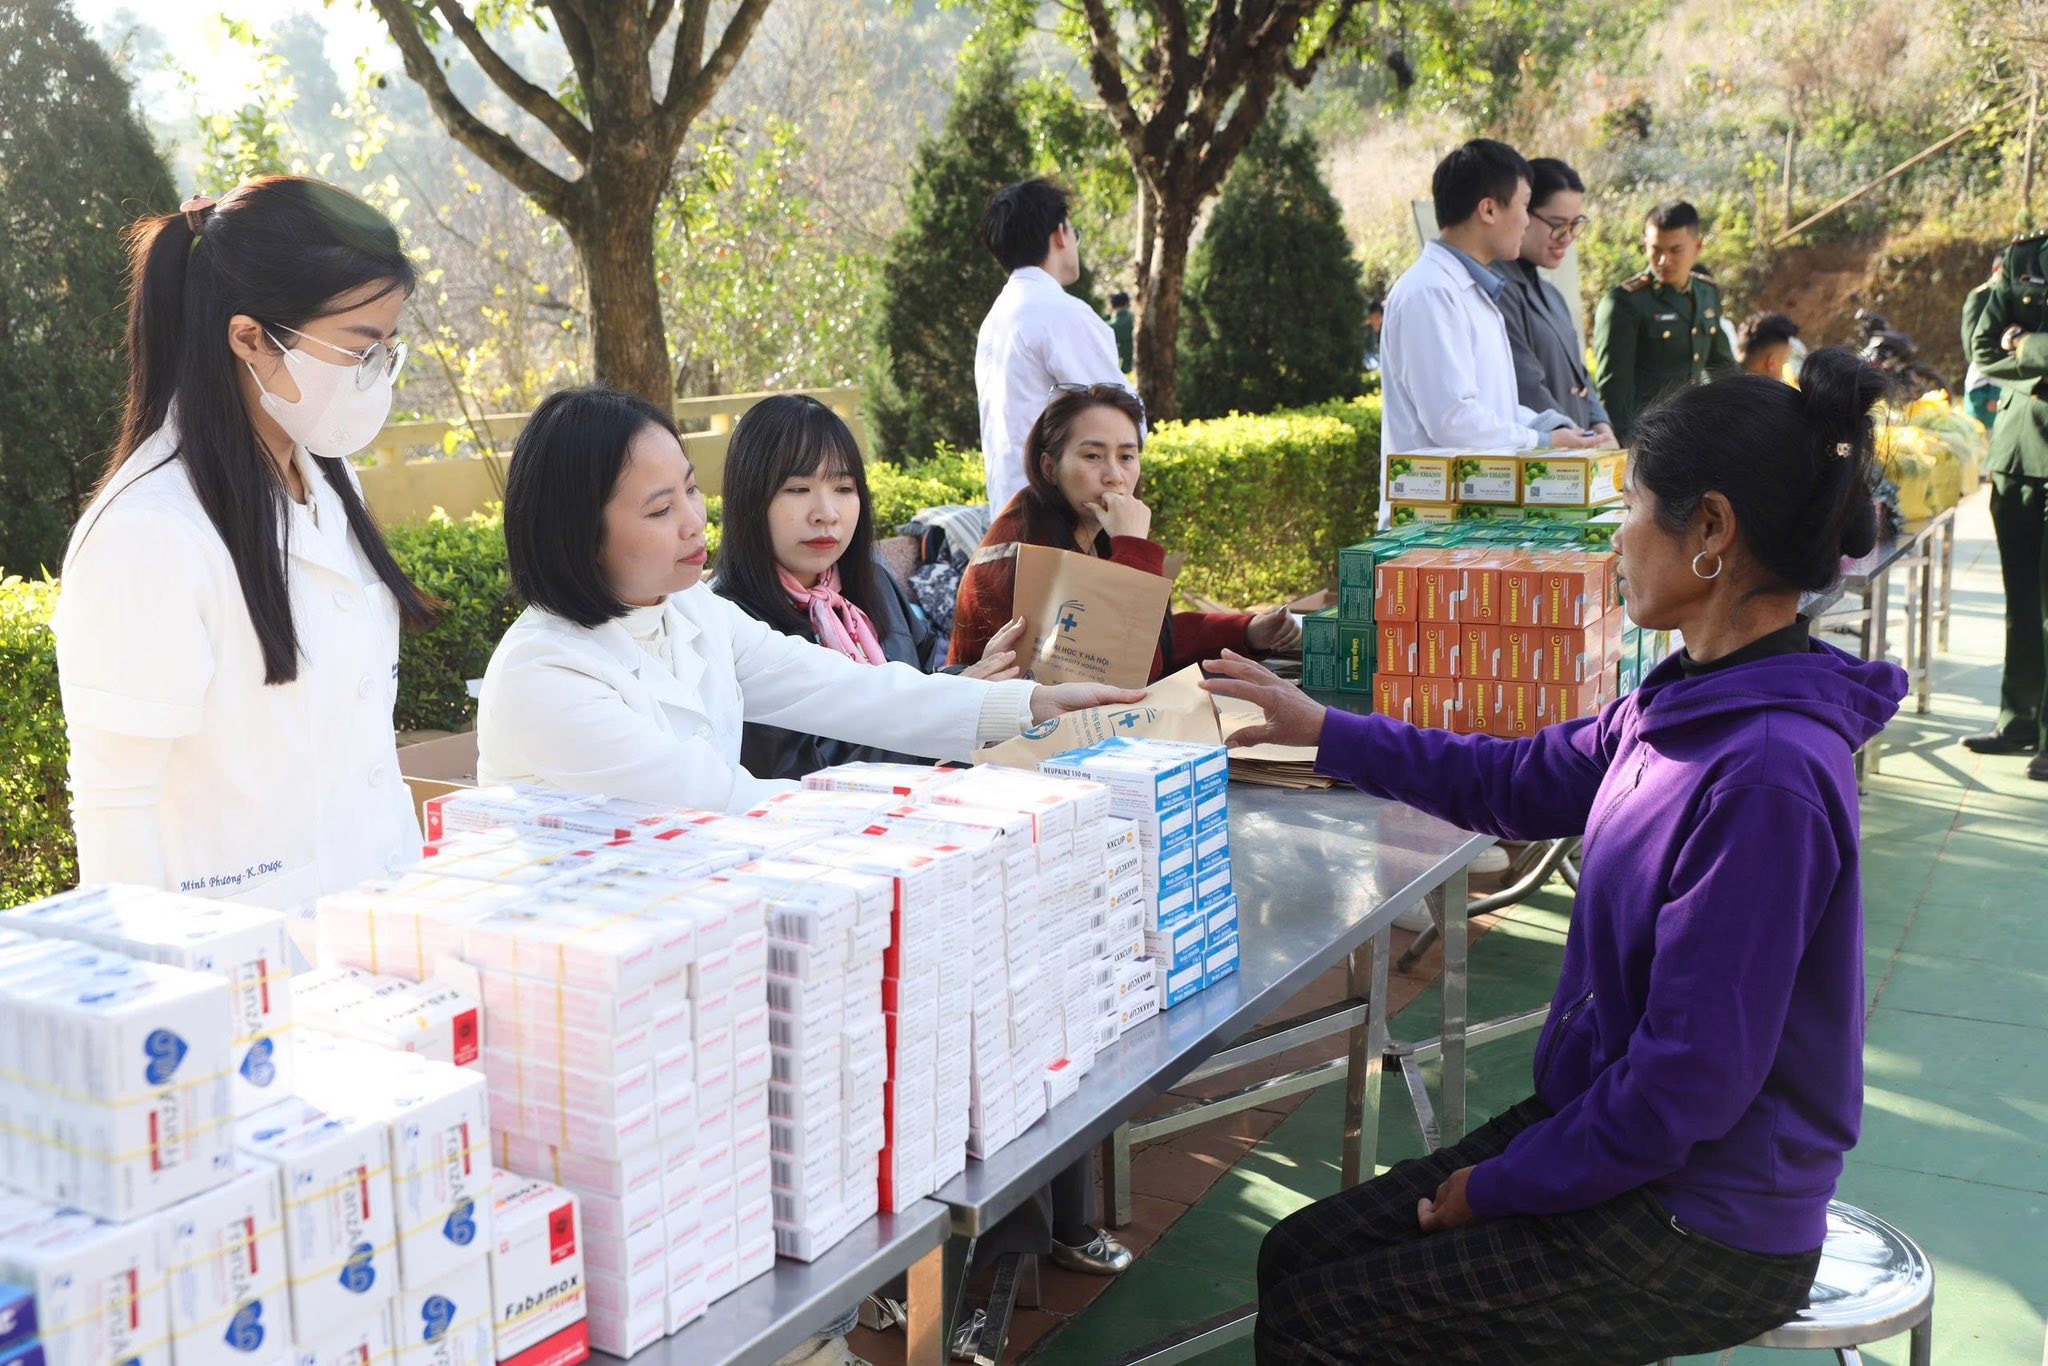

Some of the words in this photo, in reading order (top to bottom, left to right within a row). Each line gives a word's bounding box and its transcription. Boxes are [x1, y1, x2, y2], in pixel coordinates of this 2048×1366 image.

[1043, 767, 1071, 777] NEUPAINZ
[1082, 772, 1091, 780] mg
[180, 877, 206, 892] Minh
[1127, 971, 1152, 991] MAXXCUP
[1129, 999, 1156, 1019] MAXXCUP
[504, 1274, 579, 1321] Fabamox
